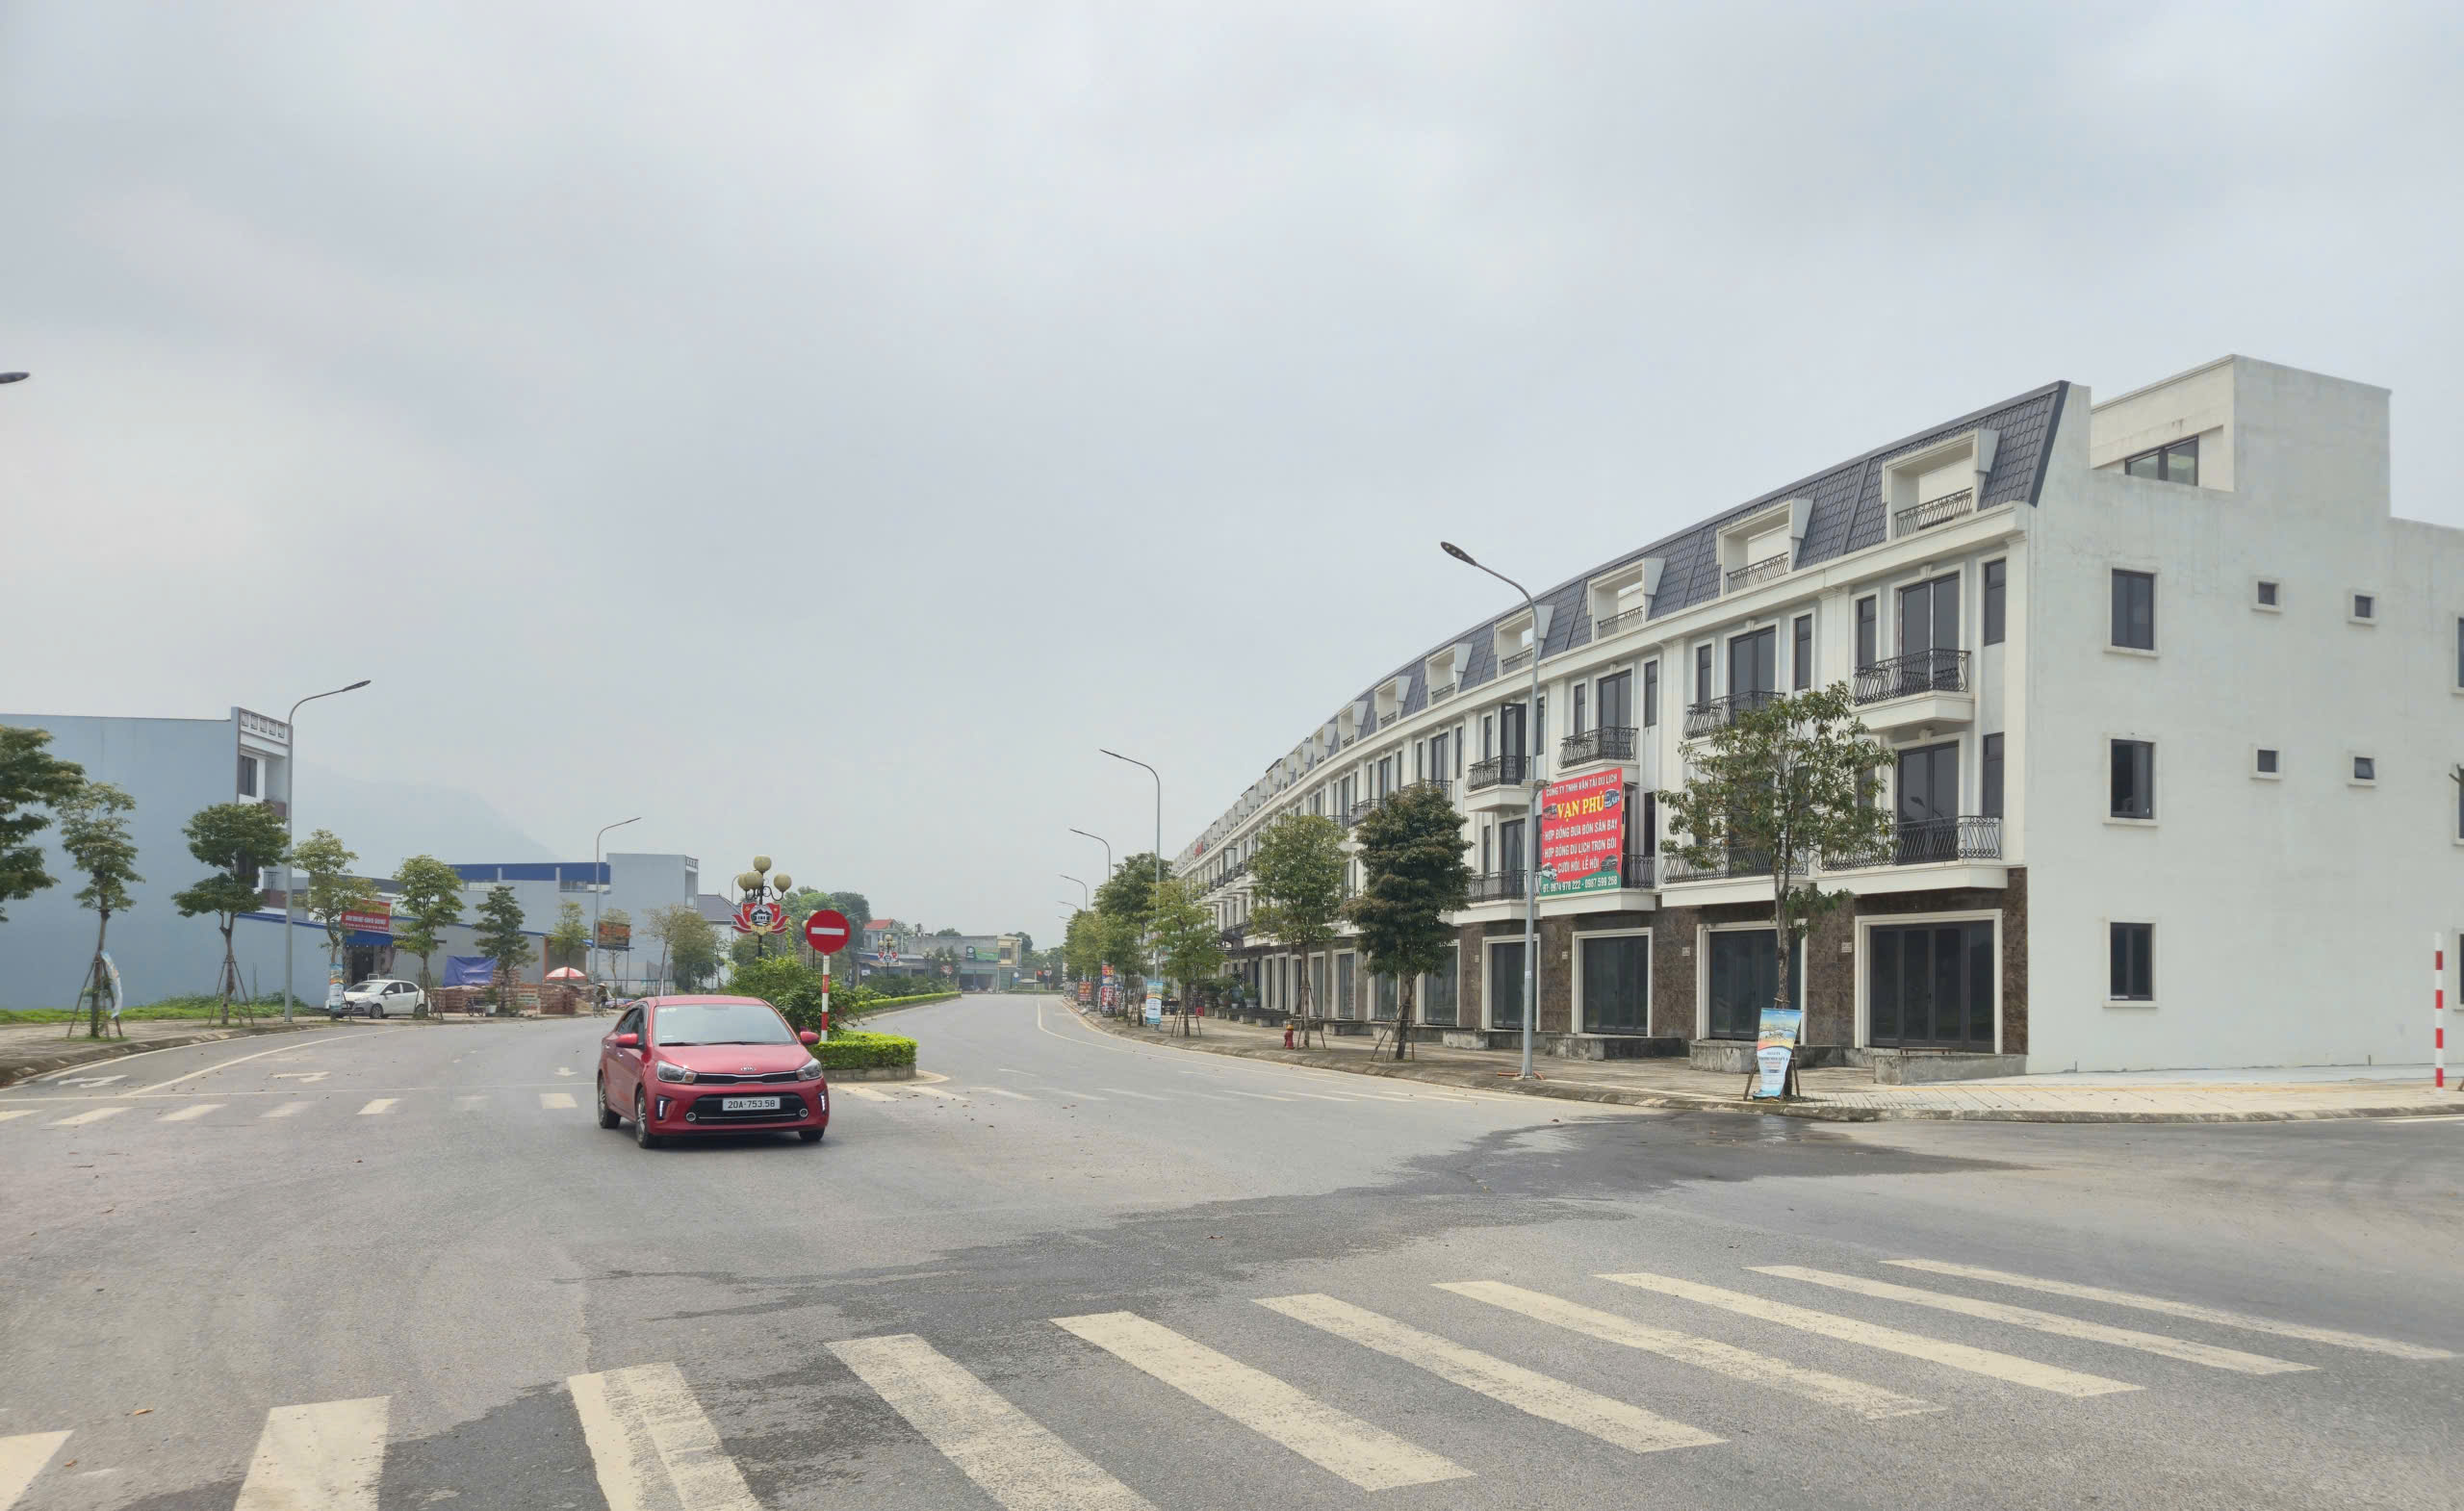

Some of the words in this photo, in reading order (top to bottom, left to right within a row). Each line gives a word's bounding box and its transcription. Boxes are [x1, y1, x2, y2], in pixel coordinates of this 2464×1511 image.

[1566, 783, 1578, 792] TNHH
[1578, 779, 1588, 790] VẬN
[1598, 777, 1604, 785] DU
[1606, 774, 1617, 784] LỊCH
[1557, 800, 1580, 822] VẠN
[1581, 790, 1604, 815] PHÚ
[1545, 830, 1554, 841] HỢP
[1555, 824, 1570, 839] ĐỒNG
[1570, 825, 1581, 837] ĐƯA
[1581, 822, 1594, 834] ĐÓN
[1594, 819, 1606, 832] SÂN
[1606, 819, 1617, 830] BAY
[1544, 847, 1554, 859] HỢP
[1554, 843, 1570, 858] ĐỒNG
[1570, 844, 1578, 855] DU
[1578, 841, 1591, 855] LỊCH
[1591, 838, 1606, 853] TRỌN
[1606, 835, 1617, 849] GÓI
[1572, 880, 1581, 890] 222
